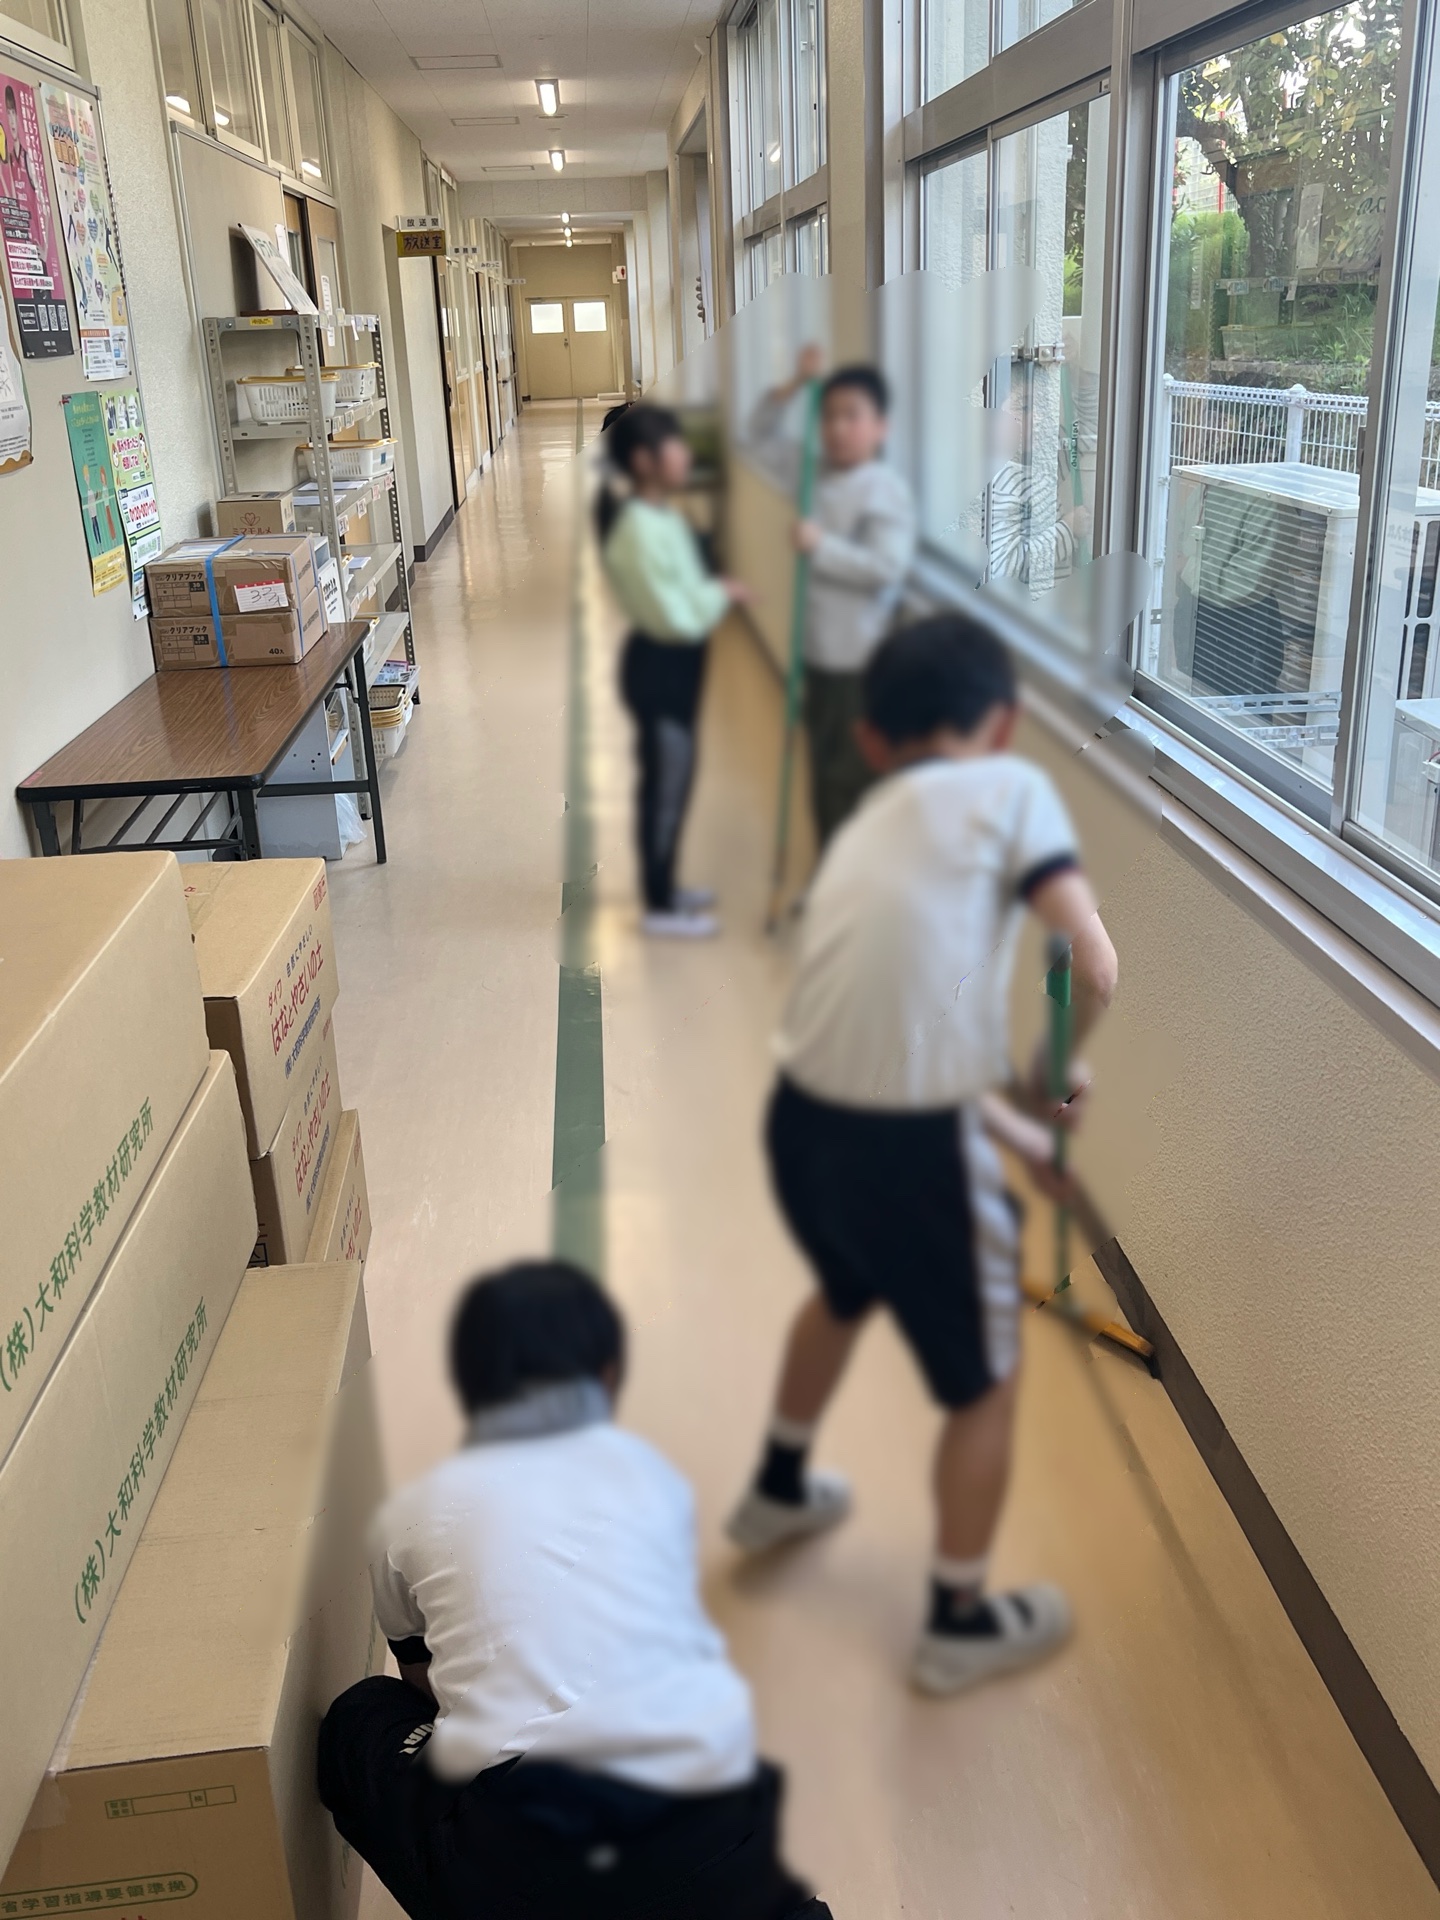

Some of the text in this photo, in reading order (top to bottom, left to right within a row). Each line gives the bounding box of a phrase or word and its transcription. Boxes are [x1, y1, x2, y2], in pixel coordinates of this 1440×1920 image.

[407, 218, 439, 227] 放送室
[404, 236, 442, 250] 放送室
[232, 527, 272, 535] ミマモルメ
[166, 573, 203, 581] クリアブック
[170, 626, 207, 634] クリアブック
[268, 924, 313, 1016] ダイワ 自然にやさしい
[271, 939, 324, 1056] はなとやさいの土
[0, 1096, 154, 1392] (株)大和科学教材研究所
[75, 1296, 208, 1624] (株)大和科学教材研究所
